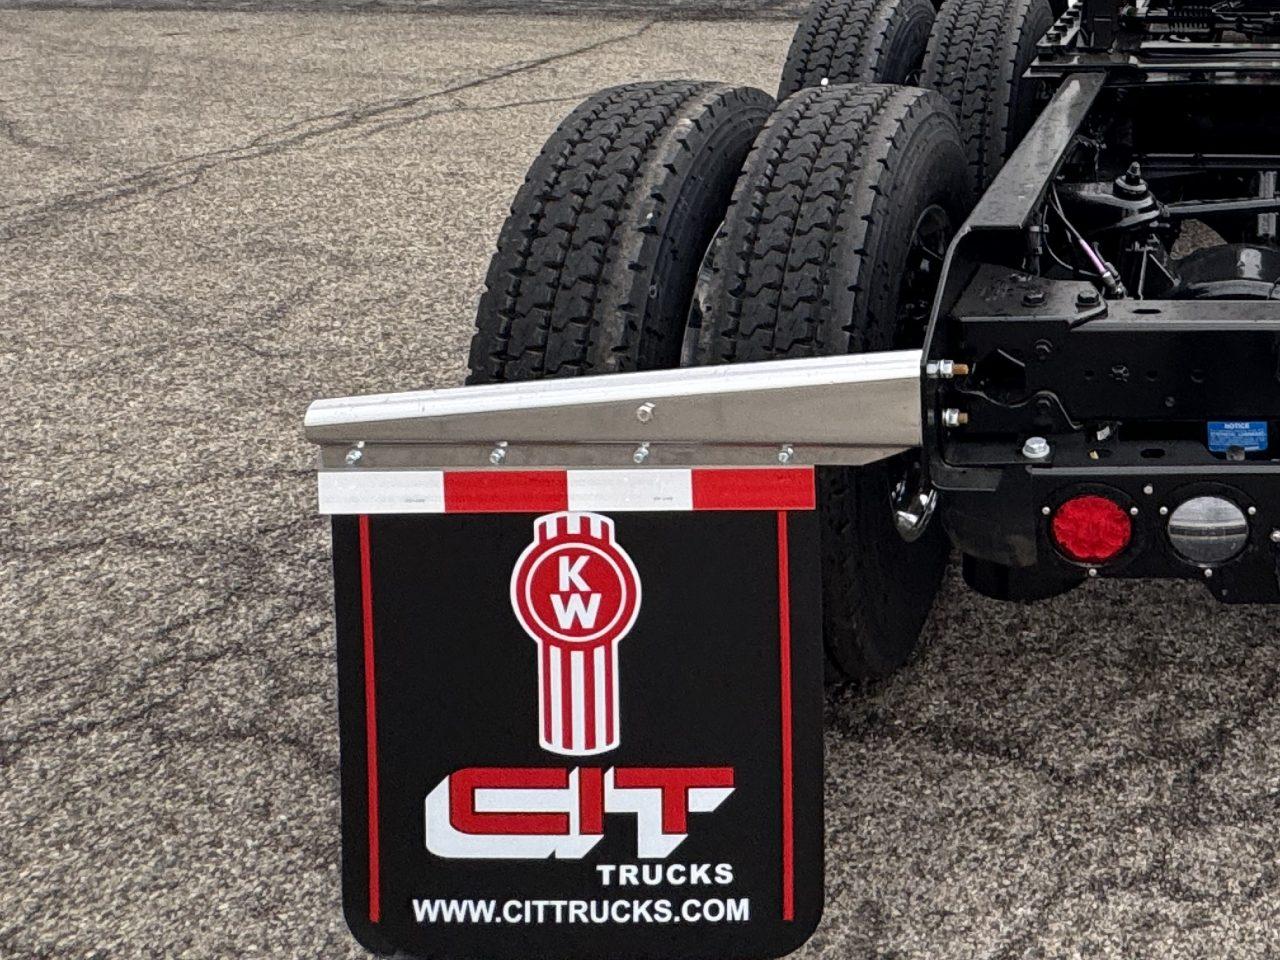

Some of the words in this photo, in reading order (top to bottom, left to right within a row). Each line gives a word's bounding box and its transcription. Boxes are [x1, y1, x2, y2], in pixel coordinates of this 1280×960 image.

[558, 555, 590, 592] K
[549, 593, 602, 630] W
[447, 766, 735, 835] CIT
[597, 863, 734, 886] TRUCKS
[412, 898, 750, 924] WWW.CITTRUCKS.COM
